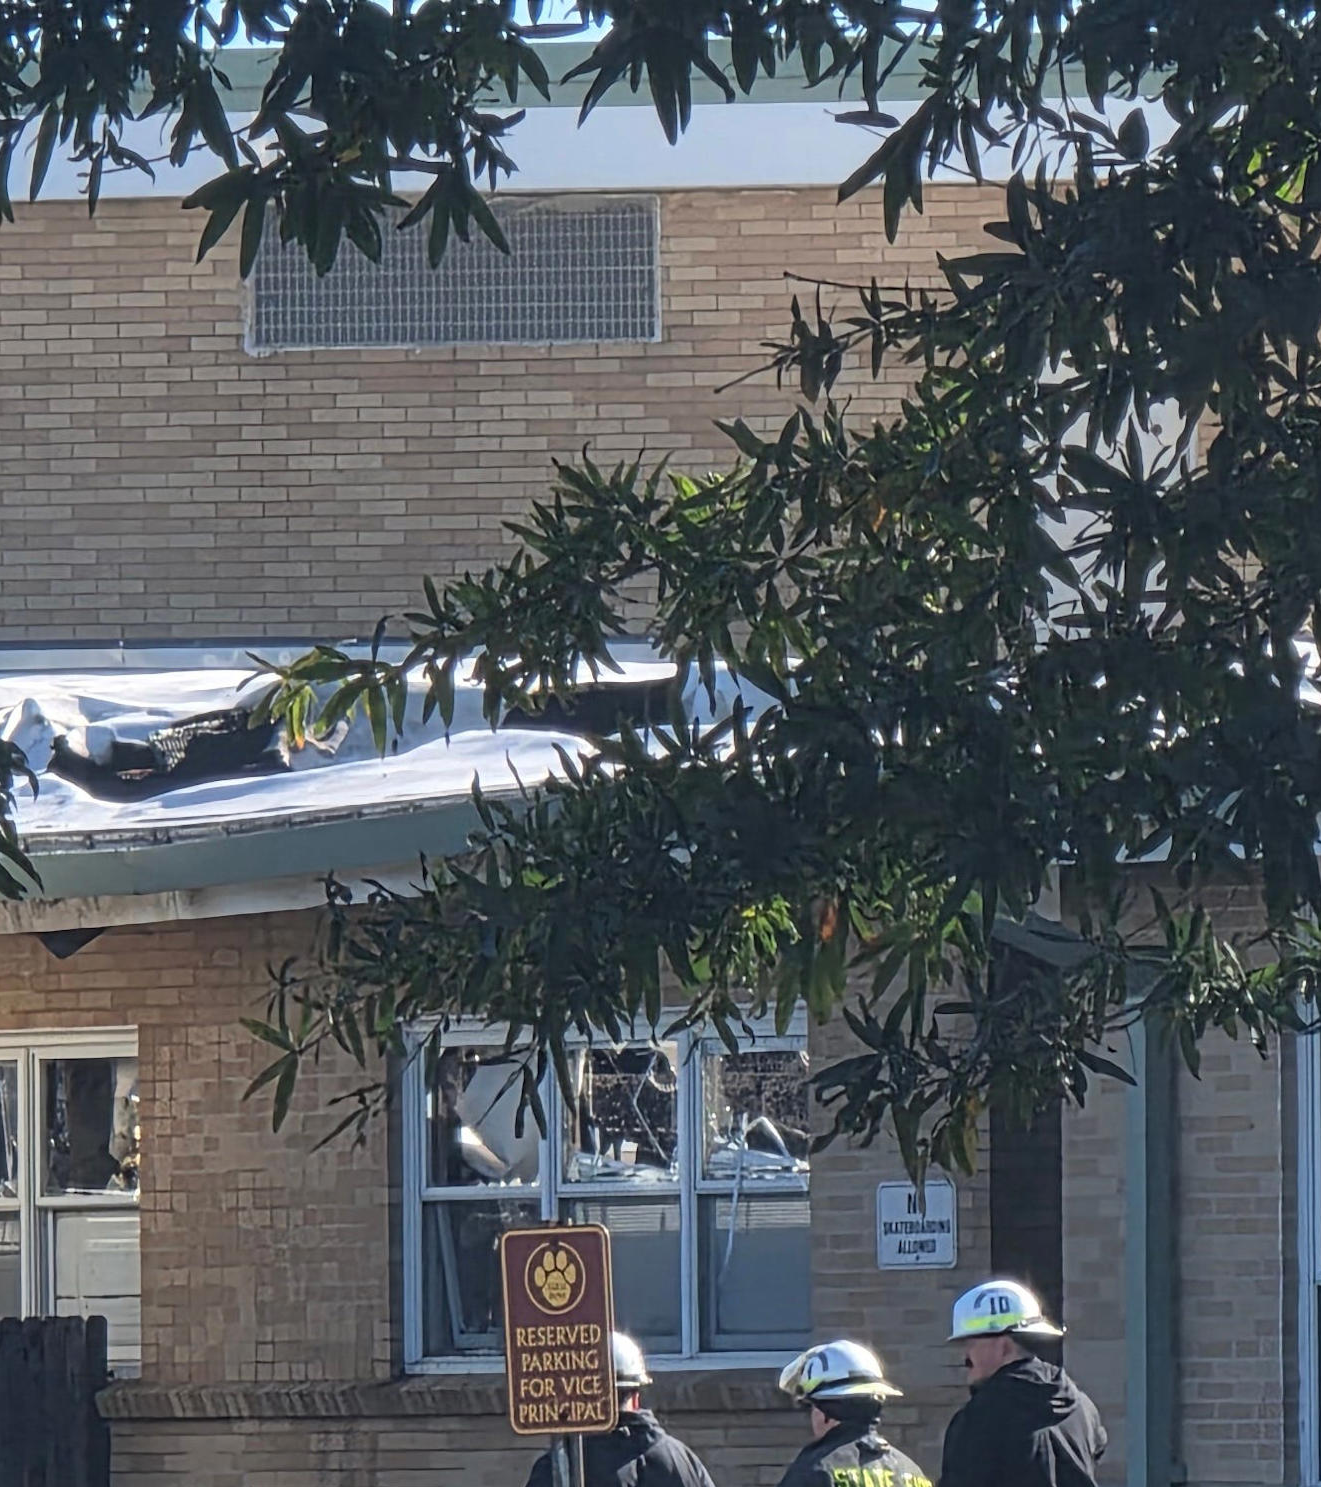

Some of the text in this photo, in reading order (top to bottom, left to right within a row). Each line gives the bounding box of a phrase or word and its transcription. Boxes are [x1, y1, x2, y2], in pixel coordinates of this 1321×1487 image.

[516, 1324, 601, 1347] RESERVED
[521, 1350, 599, 1372] PARKING
[520, 1375, 603, 1398] FOR VICE
[519, 1402, 606, 1423] PRINCIPAL
